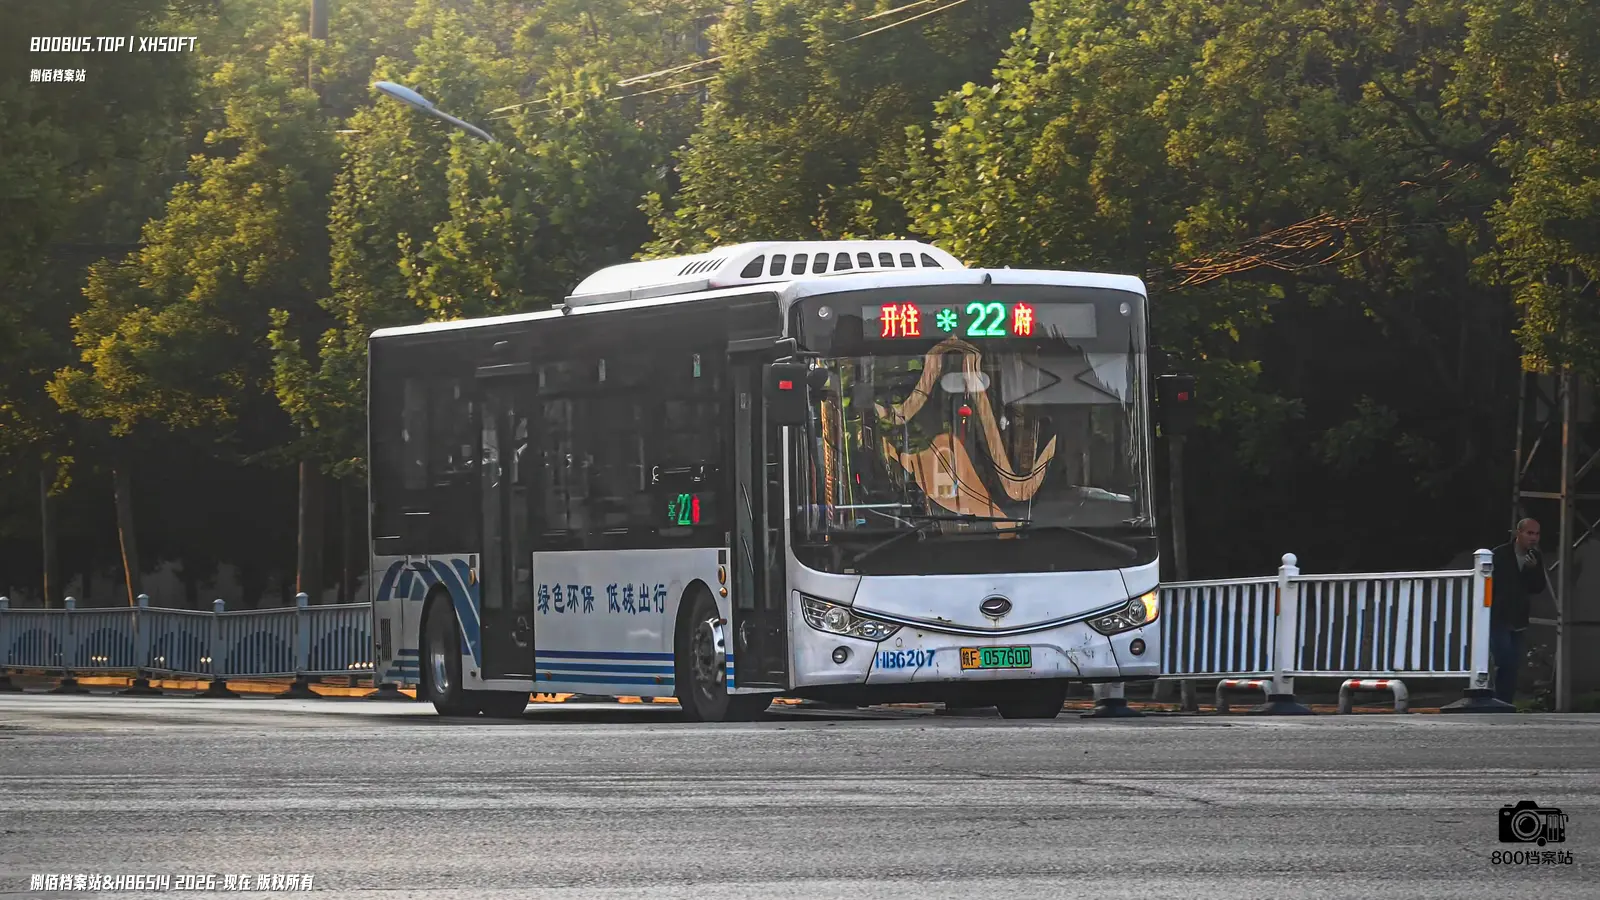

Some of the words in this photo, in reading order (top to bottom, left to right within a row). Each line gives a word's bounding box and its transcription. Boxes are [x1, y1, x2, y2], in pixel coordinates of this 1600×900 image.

[880, 303, 920, 337] 开往
[966, 302, 1006, 336] 22
[1014, 303, 1033, 336] 府
[677, 493, 691, 525] 22
[537, 582, 595, 615] 绿色环保
[606, 582, 667, 615] 低碳出行
